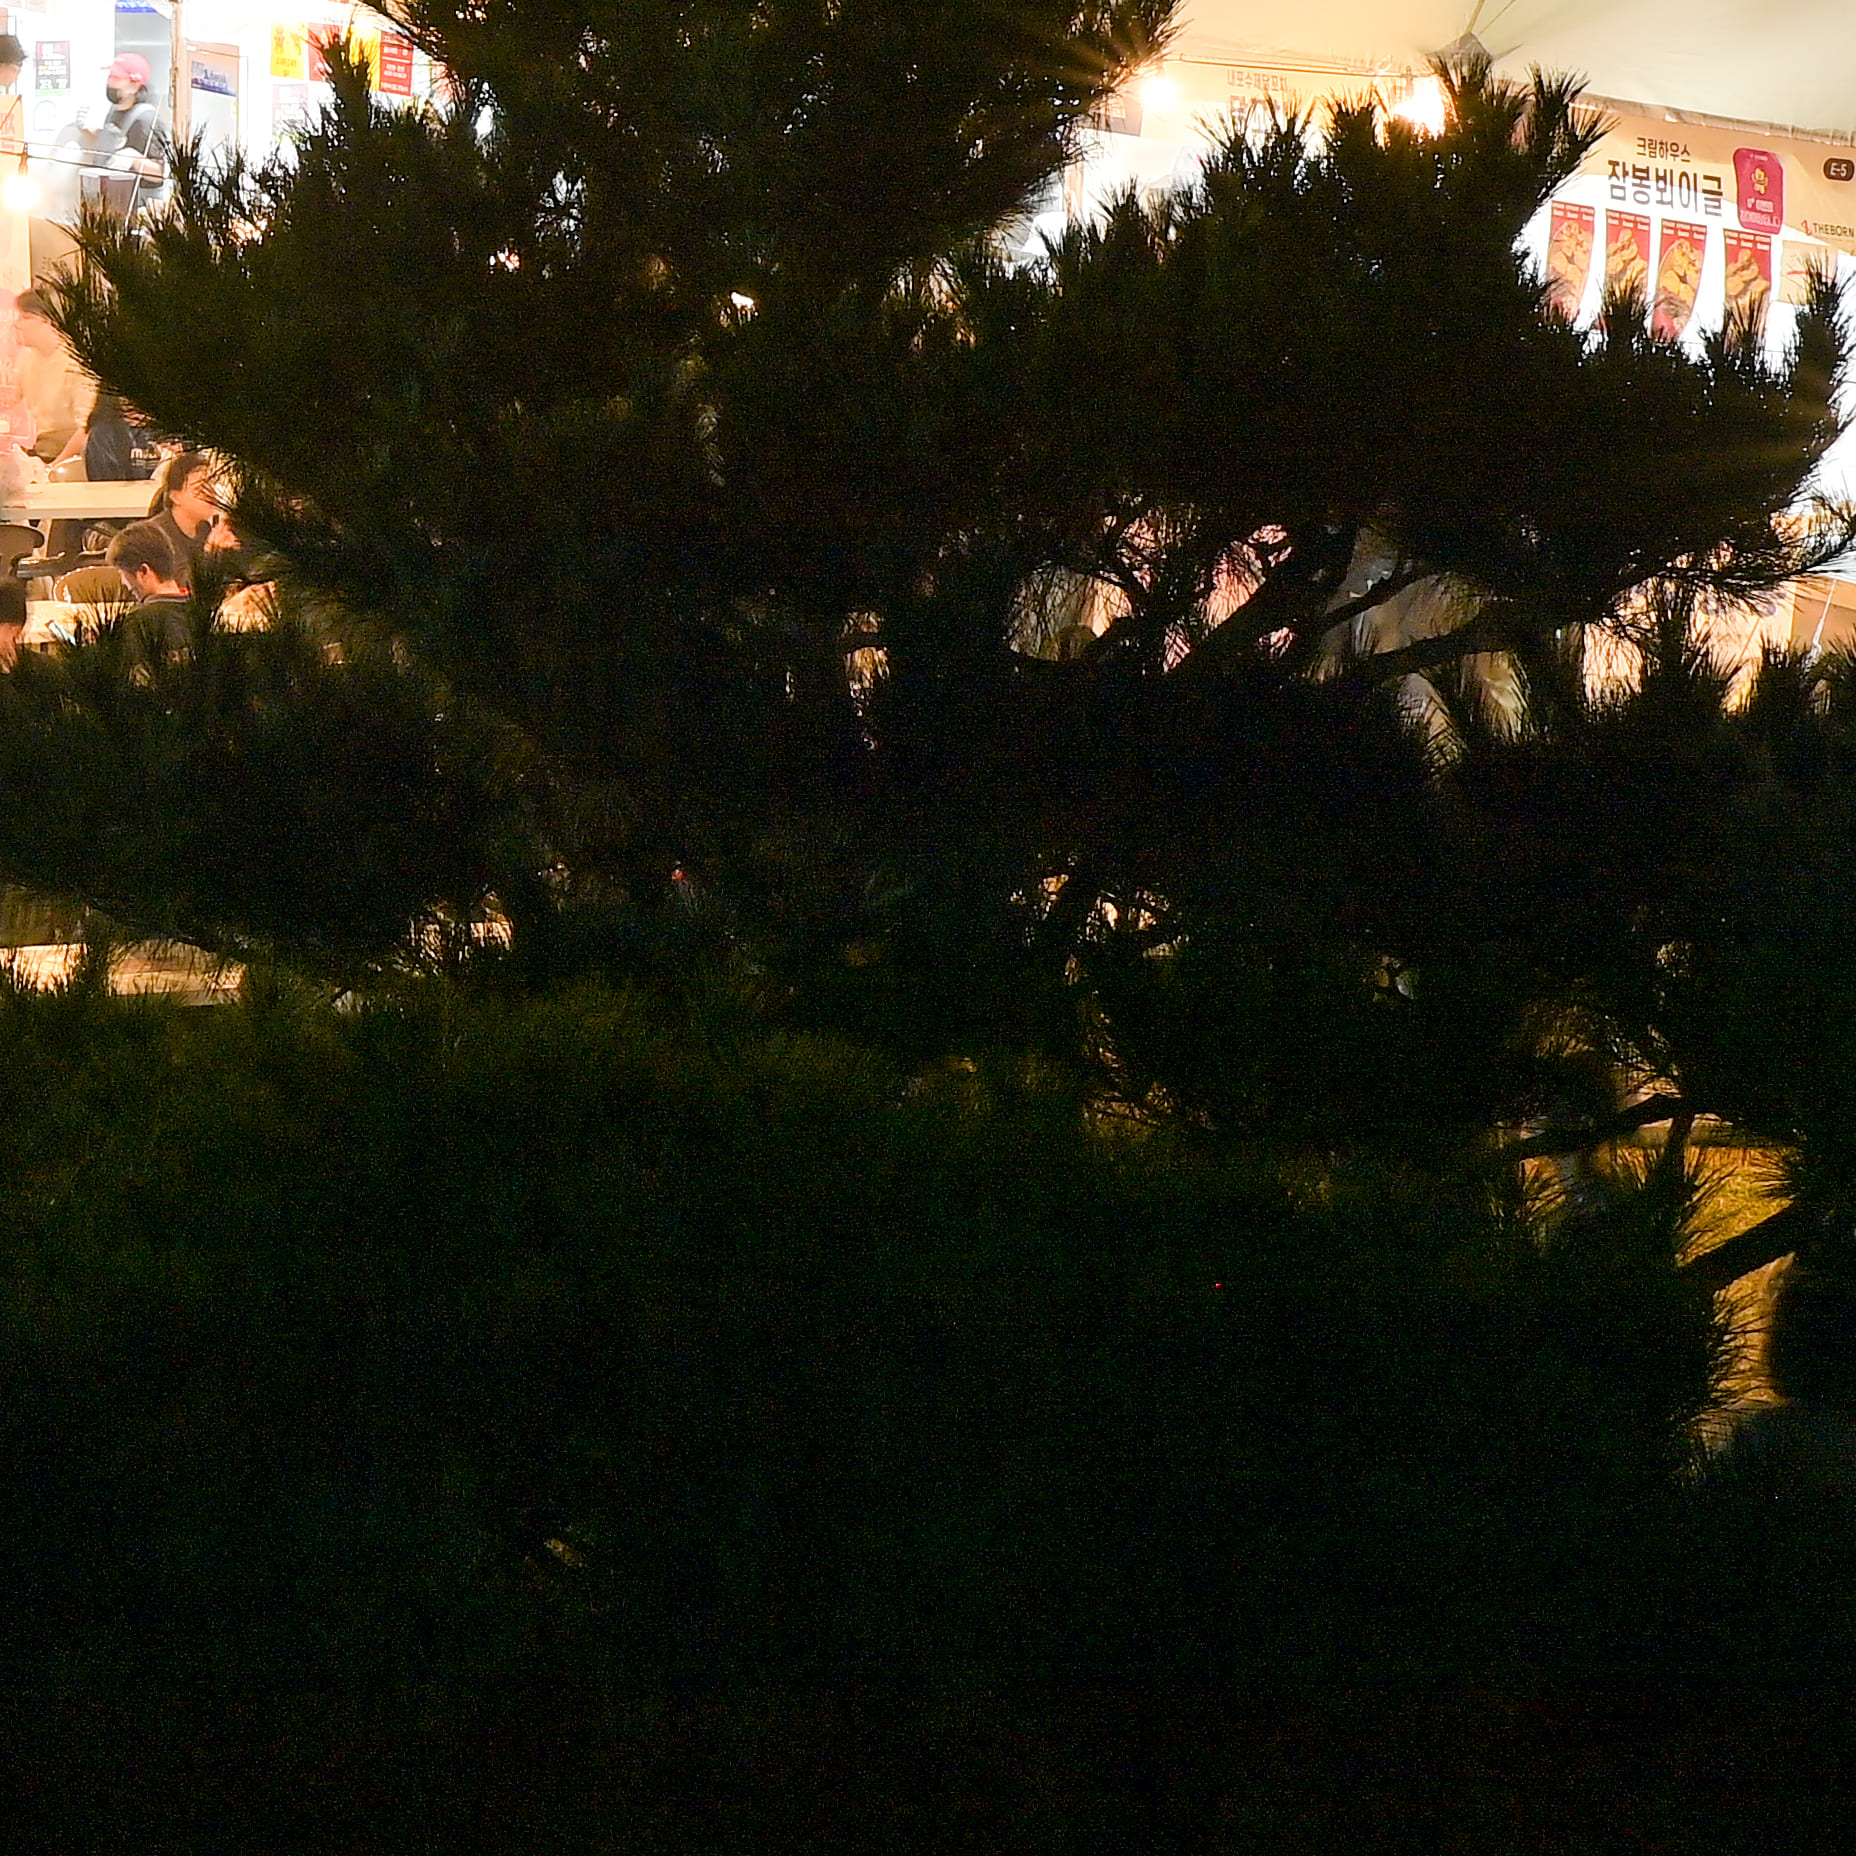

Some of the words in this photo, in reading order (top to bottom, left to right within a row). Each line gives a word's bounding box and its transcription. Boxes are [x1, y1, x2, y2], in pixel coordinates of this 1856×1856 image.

[1636, 137, 1691, 163] 크림하우스
[1829, 162, 1848, 177] E-5
[1608, 159, 1724, 217] 잠봉뵈이글
[1812, 223, 1855, 238] THEBORN
